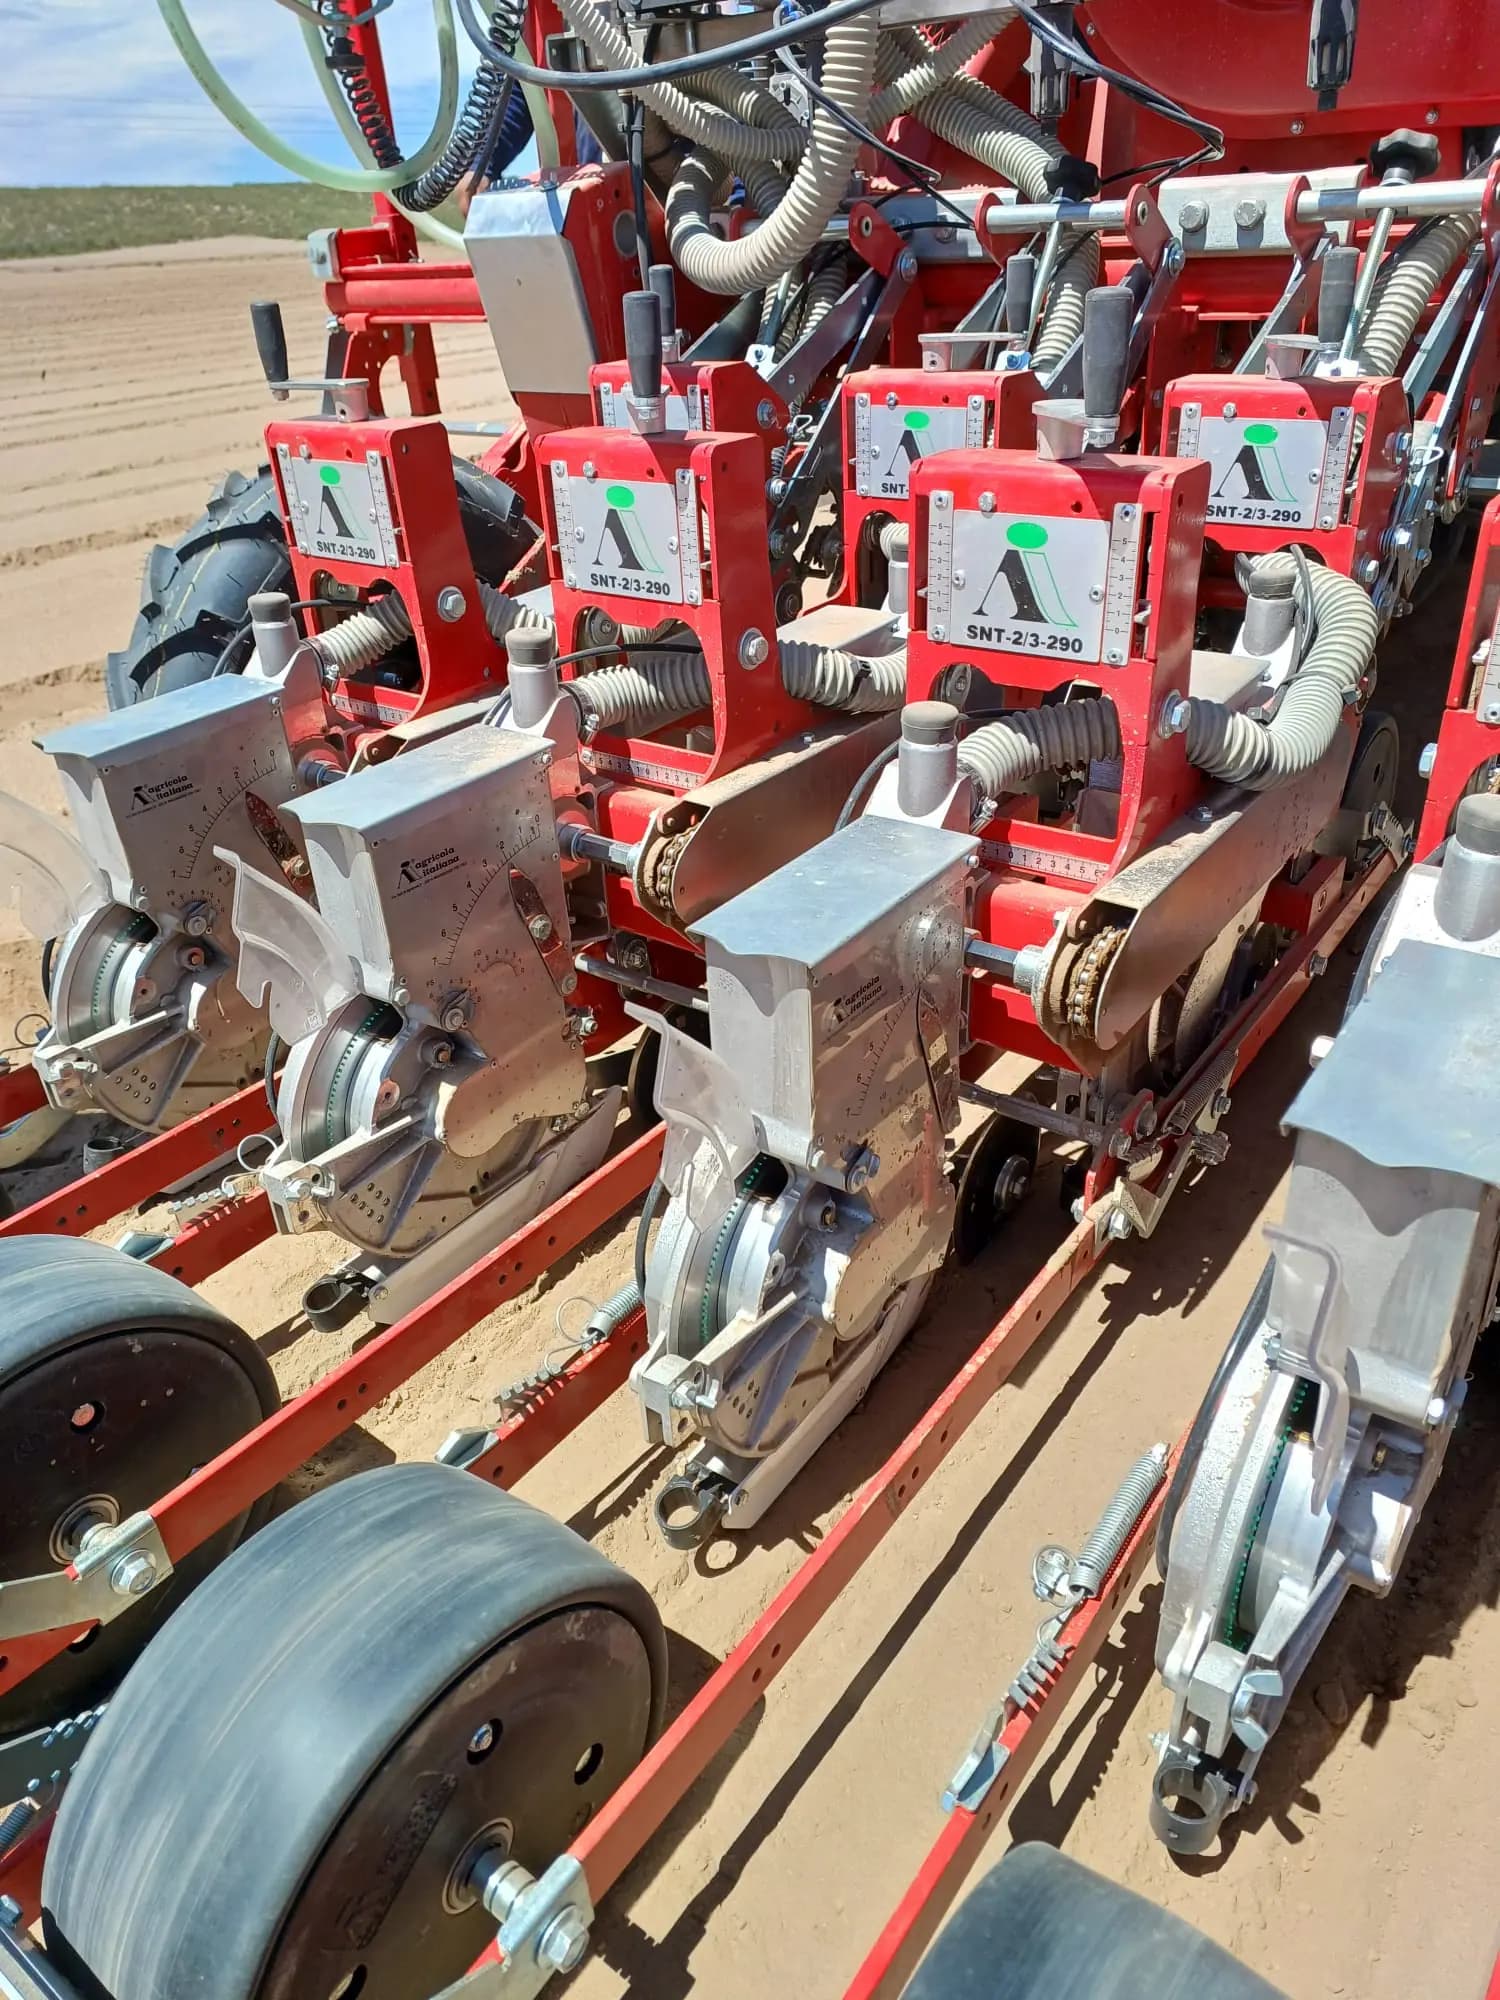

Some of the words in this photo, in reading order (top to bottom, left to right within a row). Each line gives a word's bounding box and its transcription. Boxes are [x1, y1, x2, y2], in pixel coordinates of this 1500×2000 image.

[1206, 505, 1301, 523] SNT-2/3-290
[317, 541, 376, 560] SNT-2/3-290
[590, 573, 671, 596] SNT-2/3-290
[966, 624, 1083, 653] SNT-2/3-290
[415, 847, 455, 869] agricola
[423, 855, 459, 876] italiana
